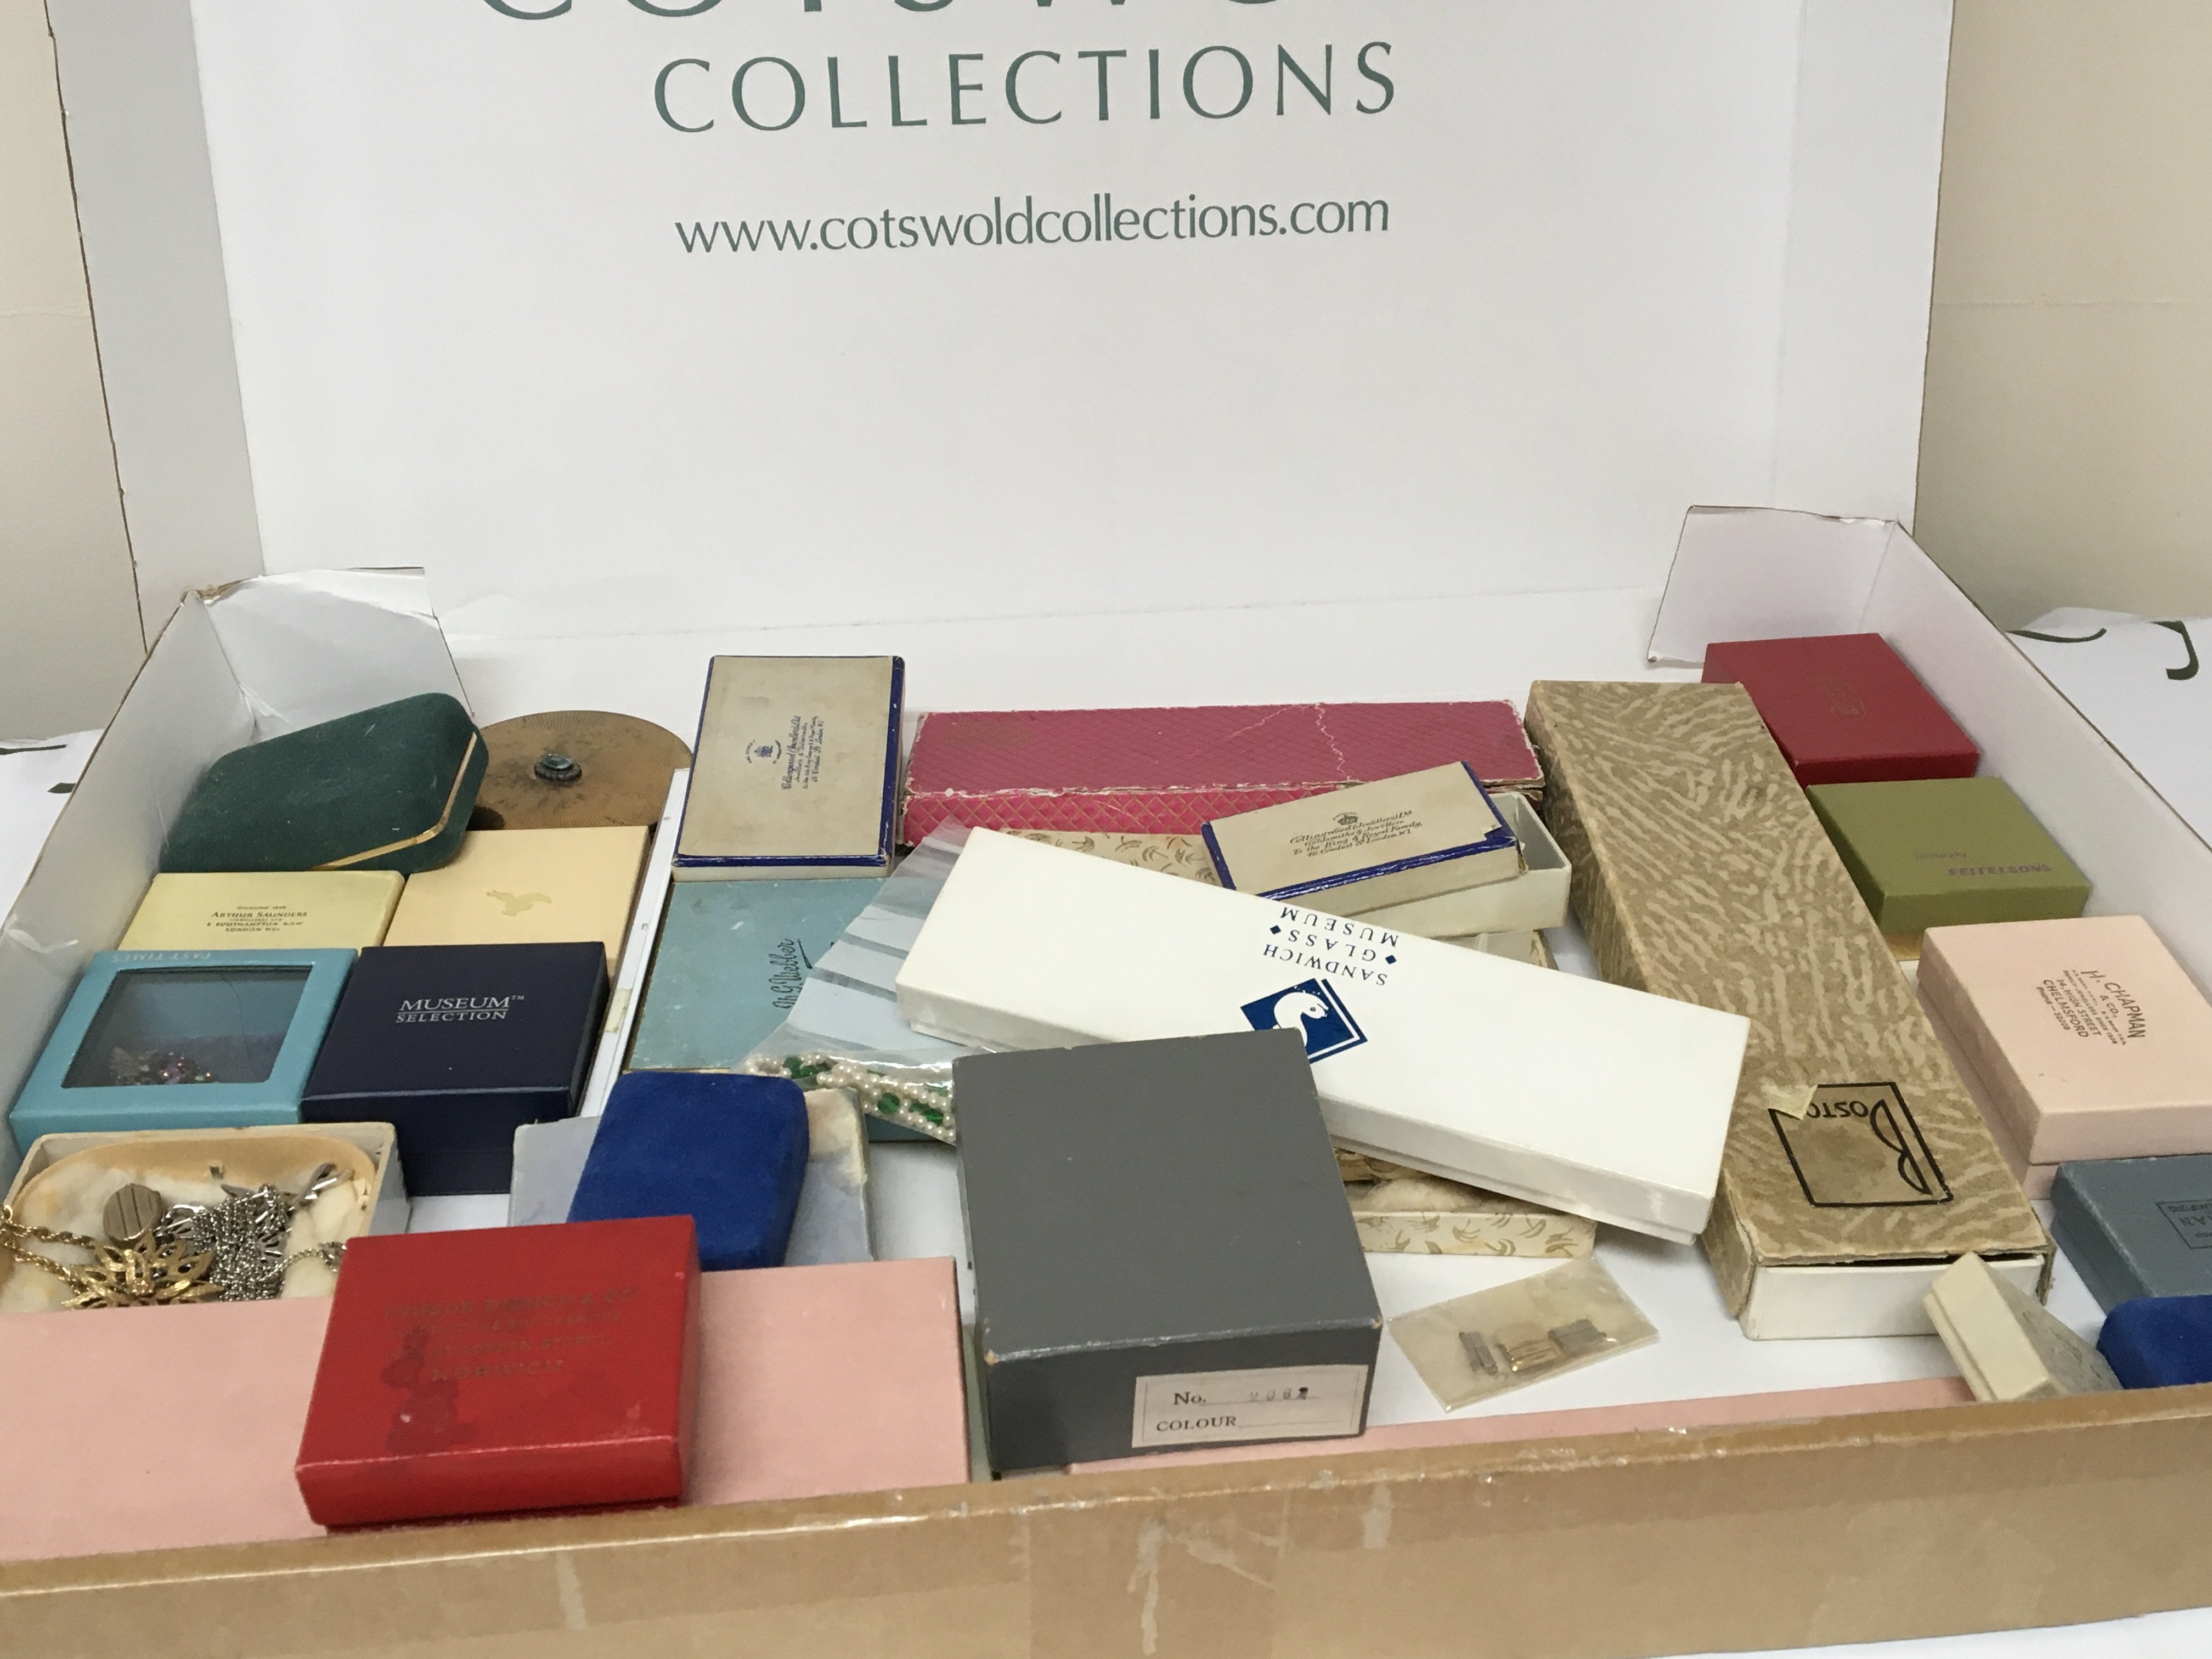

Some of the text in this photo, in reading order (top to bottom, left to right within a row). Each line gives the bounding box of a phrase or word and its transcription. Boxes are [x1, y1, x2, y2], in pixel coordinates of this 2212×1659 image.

[654, 42, 1394, 132] COLLECTIONS
[675, 193, 1388, 252] www.cotswoldcollections.com
[1280, 907, 1399, 947] MUSEUM
[1288, 929, 1376, 961] GLASS
[1263, 944, 1387, 986] SANDWICH
[396, 1011, 507, 1023] SELECTION
[2043, 979, 2089, 1037] CHELMSFORD
[2063, 989, 2081, 1007] HIGH
[2077, 1009, 2102, 1036] STREET
[2081, 970, 2106, 983] H.
[2104, 982, 2146, 1038] CHAPMAN
[1174, 1391, 1206, 1406] No.
[1156, 1415, 1237, 1432] COLOUR
